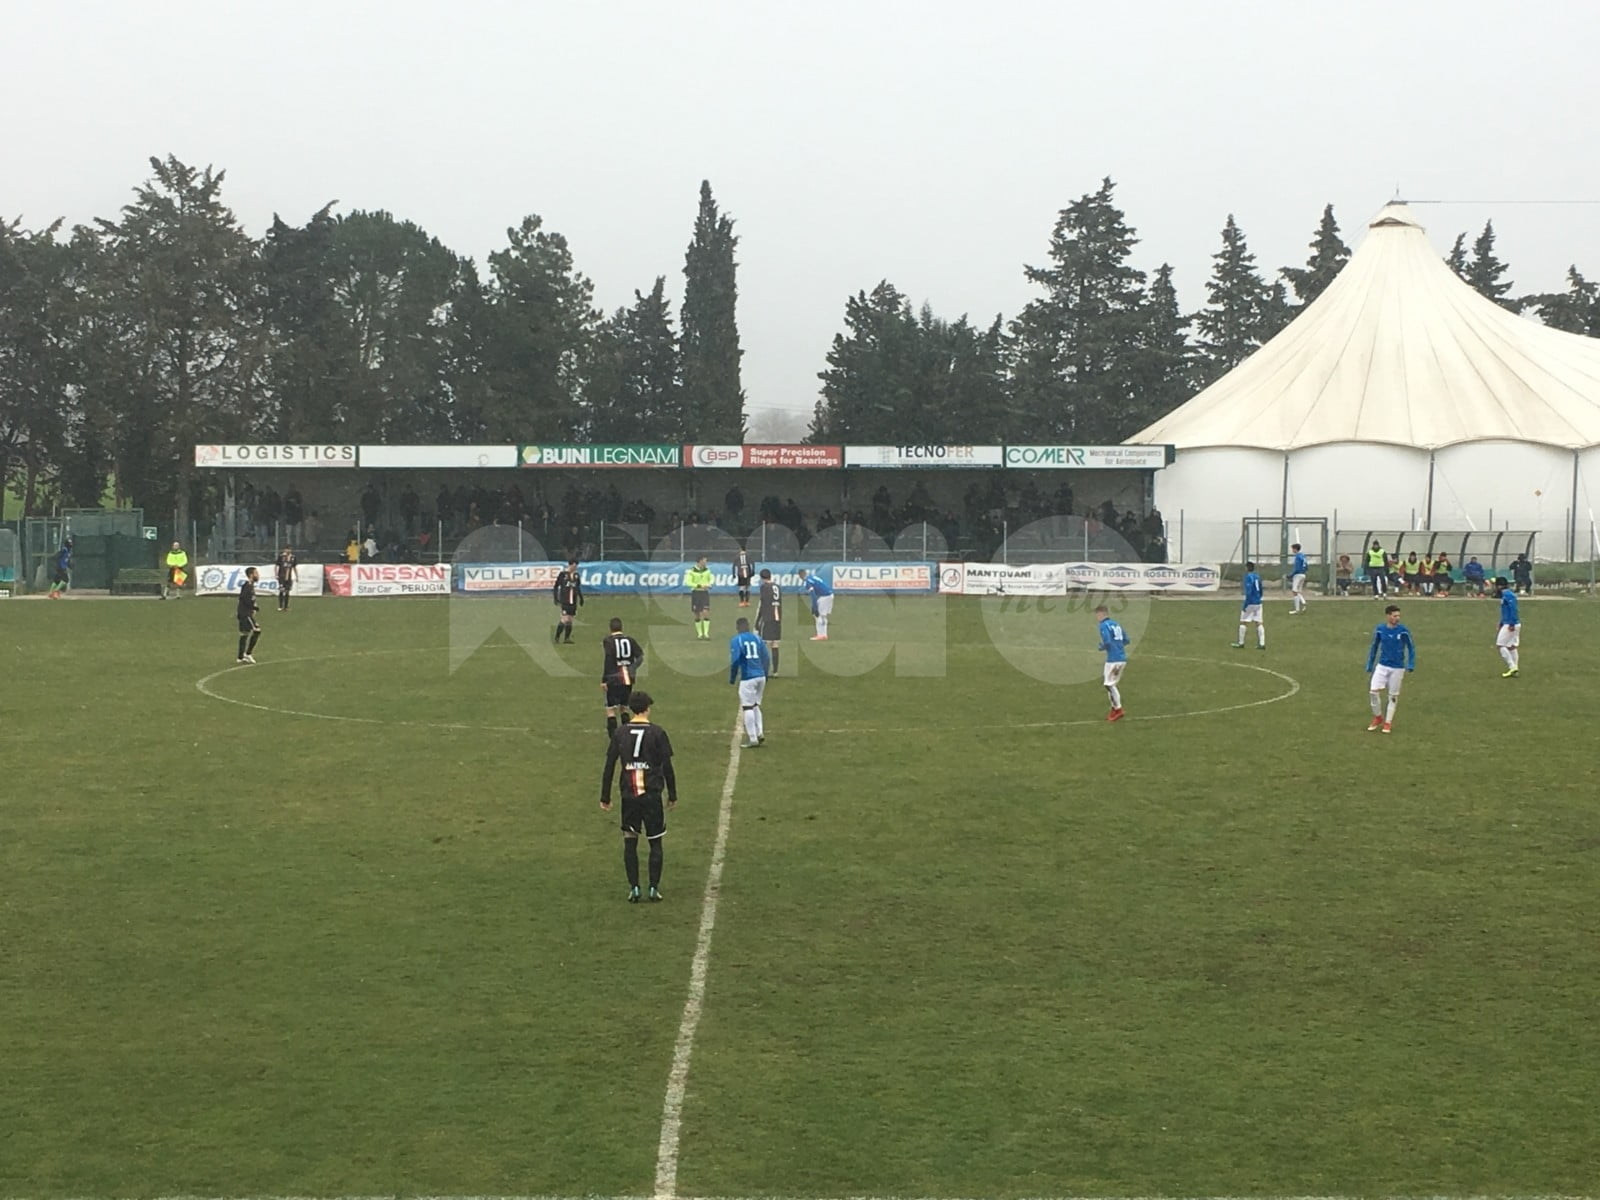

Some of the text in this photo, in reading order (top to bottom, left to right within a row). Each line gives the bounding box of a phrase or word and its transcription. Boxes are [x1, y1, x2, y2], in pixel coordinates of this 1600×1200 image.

[221, 446, 353, 459] LOGISTICS
[543, 448, 679, 464] BUINI LEGNAMI
[750, 448, 826, 457] Super Precision
[895, 446, 974, 458] TECNOFER
[1089, 449, 1122, 457] Mechanical
[750, 457, 838, 466] Rings for Bearings
[357, 566, 446, 580] NISSAN
[581, 569, 602, 586] La
[605, 570, 636, 586] tua
[639, 573, 679, 586] casa
[966, 569, 1032, 579] MANTOVANI
[1066, 568, 1099, 577] ROSETTI
[1103, 570, 1140, 578] ROSETTI
[1144, 569, 1180, 578] ROSETTI
[1182, 569, 1219, 578] ROSETTI
[402, 583, 446, 593] PERUGIA
[772, 585, 780, 600] 9
[614, 638, 631, 659] 10
[743, 641, 760, 659] 11
[630, 729, 645, 758] 7
